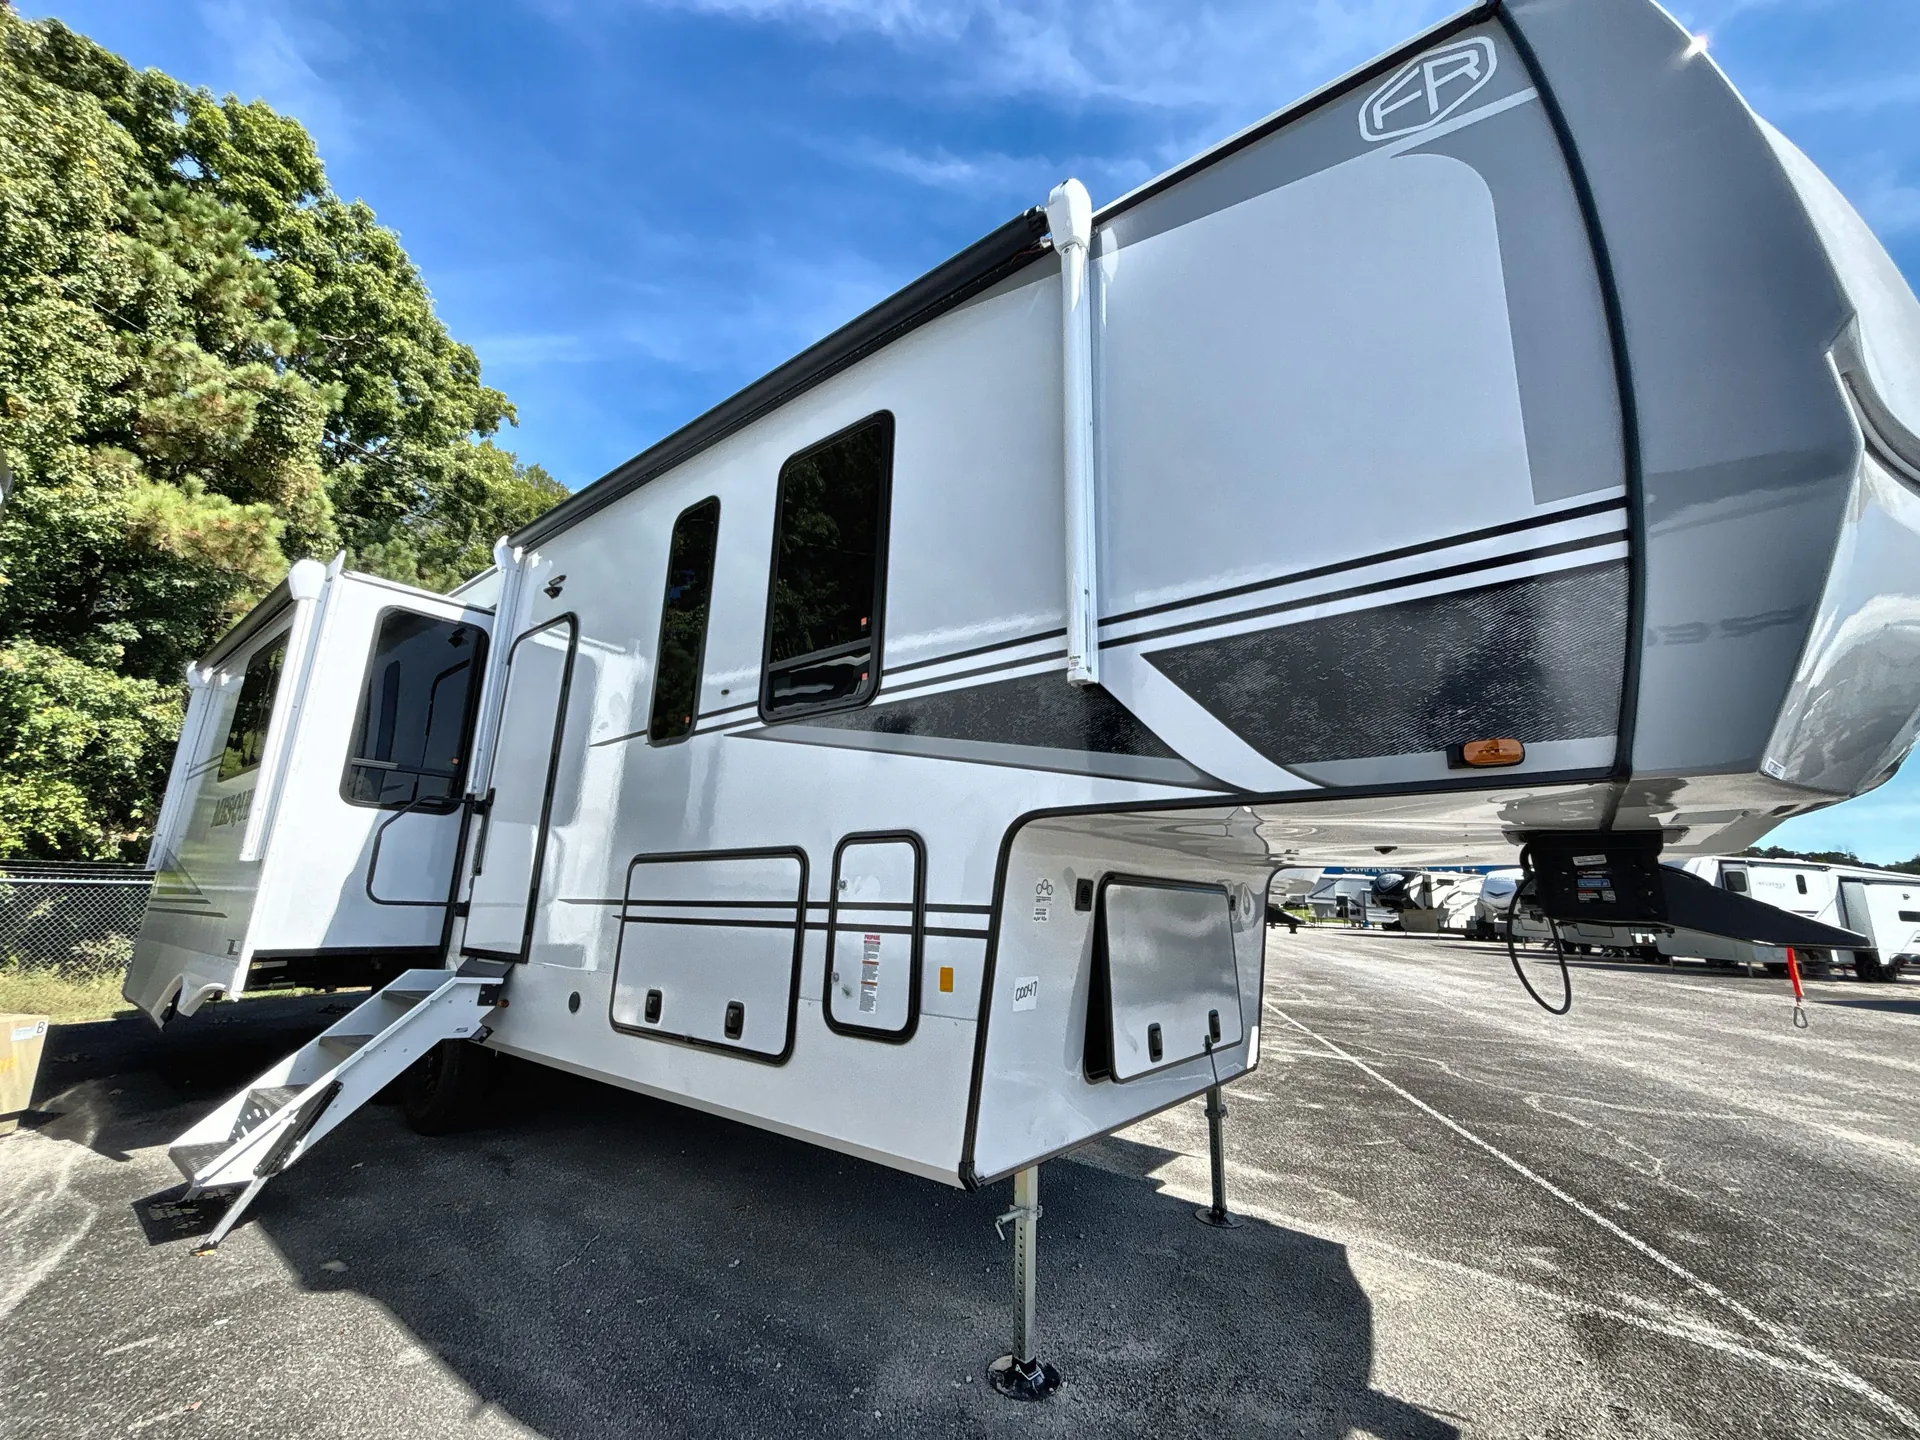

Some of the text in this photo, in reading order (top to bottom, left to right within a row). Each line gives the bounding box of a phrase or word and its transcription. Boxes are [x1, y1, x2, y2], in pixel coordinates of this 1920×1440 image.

[1372, 48, 1481, 130] FR
[210, 787, 257, 828] MESQUI
[1015, 980, 1038, 1002] 00047
